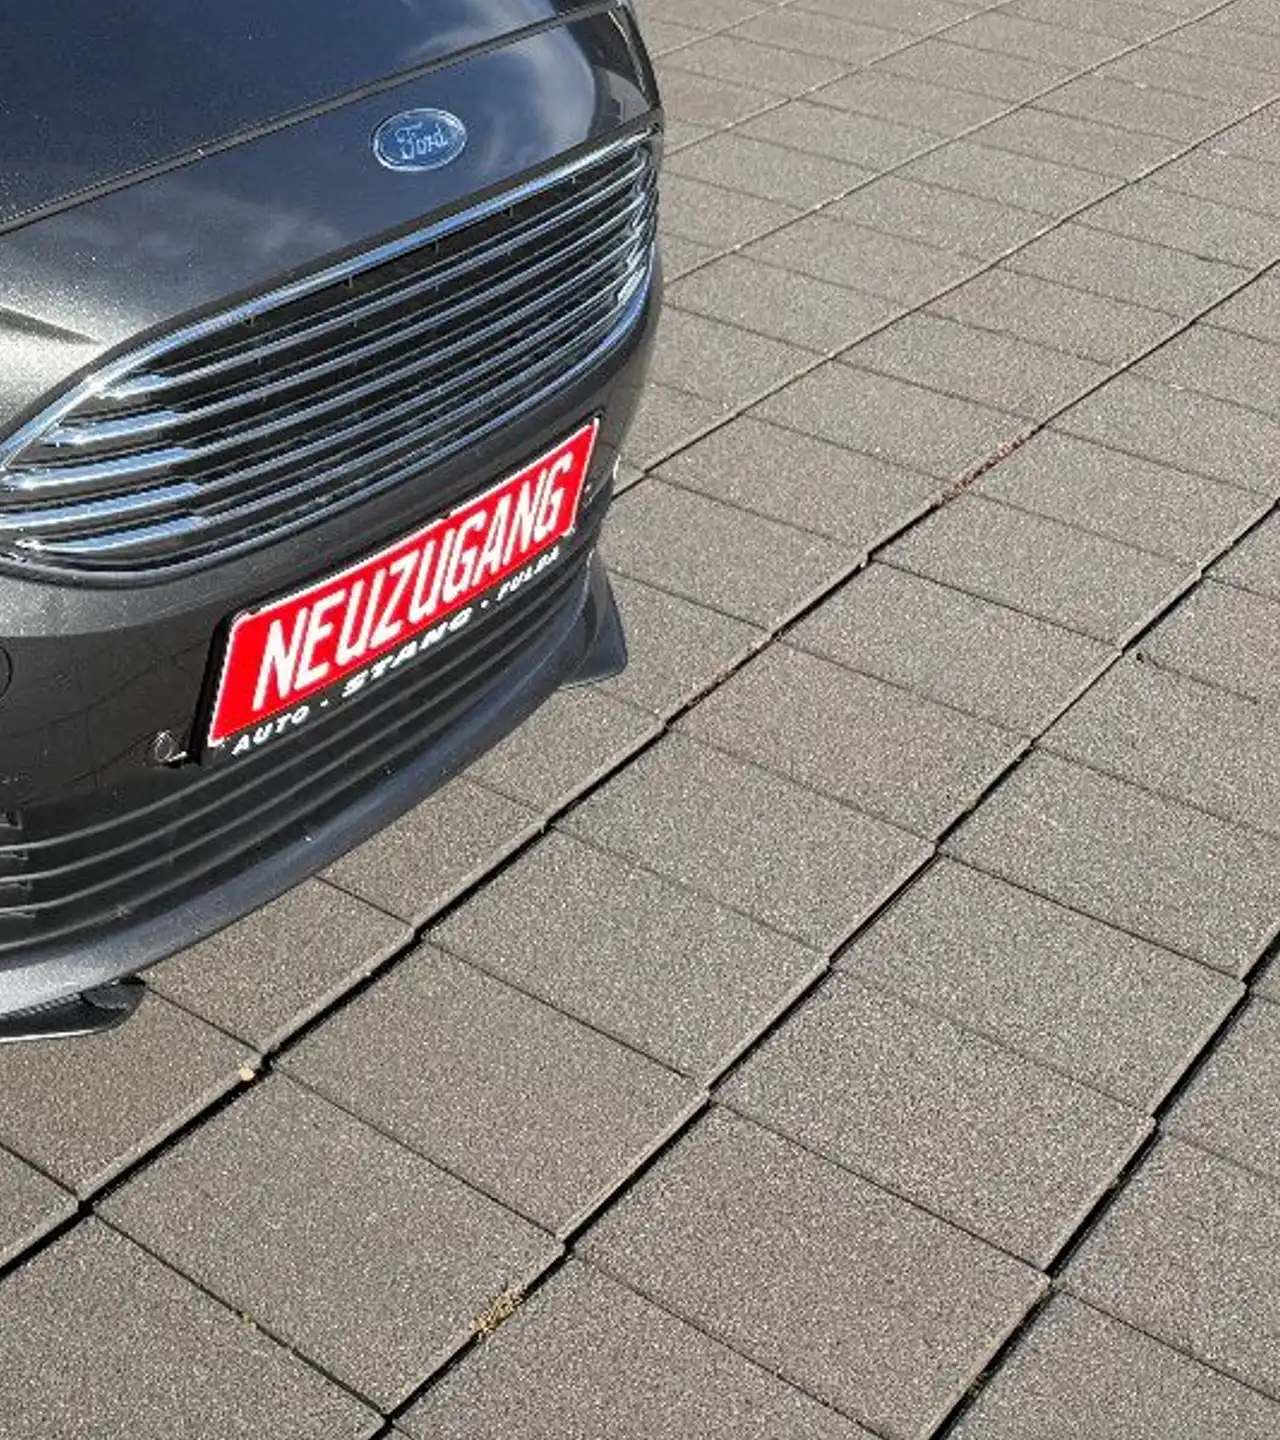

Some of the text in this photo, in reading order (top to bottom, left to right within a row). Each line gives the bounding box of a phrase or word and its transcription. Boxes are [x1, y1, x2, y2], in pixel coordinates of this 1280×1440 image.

[394, 121, 449, 160] Ford
[251, 452, 574, 711] NEUZUGANG
[231, 705, 310, 756] AUTO
[341, 607, 473, 698] STAND
